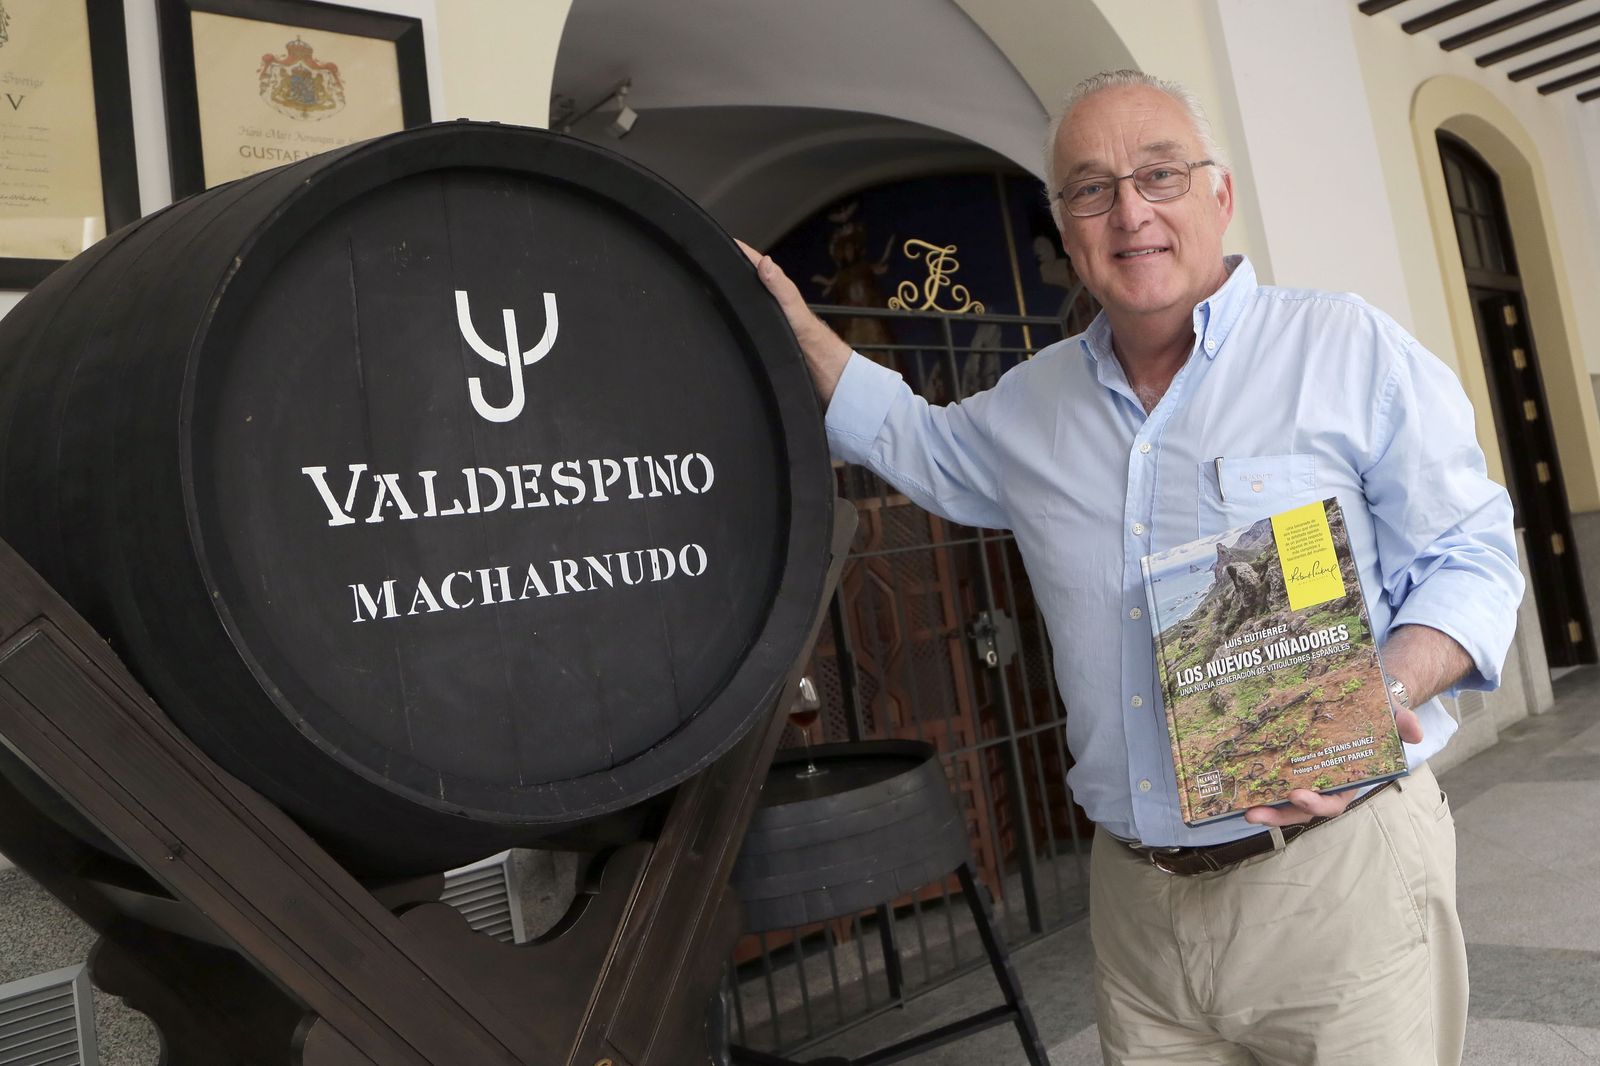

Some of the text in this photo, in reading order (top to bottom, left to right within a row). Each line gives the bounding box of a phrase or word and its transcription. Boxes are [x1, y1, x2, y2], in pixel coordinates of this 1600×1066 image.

[239, 145, 301, 161] GUSTAF
[301, 453, 715, 526] VALDESPINO
[348, 544, 708, 623] MACHARNUDO
[1176, 624, 1350, 687] LOS NUEVOS VIÑADORES
[1224, 623, 1288, 649] LUIS GUTIÉRREZ
[1180, 686, 1193, 697] UNA
[1194, 681, 1215, 693] NUEVA
[1256, 666, 1267, 675] DE
[1266, 653, 1311, 673] VITICULTORES
[1311, 642, 1351, 660] ESPAÑOLES
[1321, 755, 1347, 768] ROBERT
[1348, 748, 1374, 761] PARKER
[1324, 743, 1351, 755] ESTANIS
